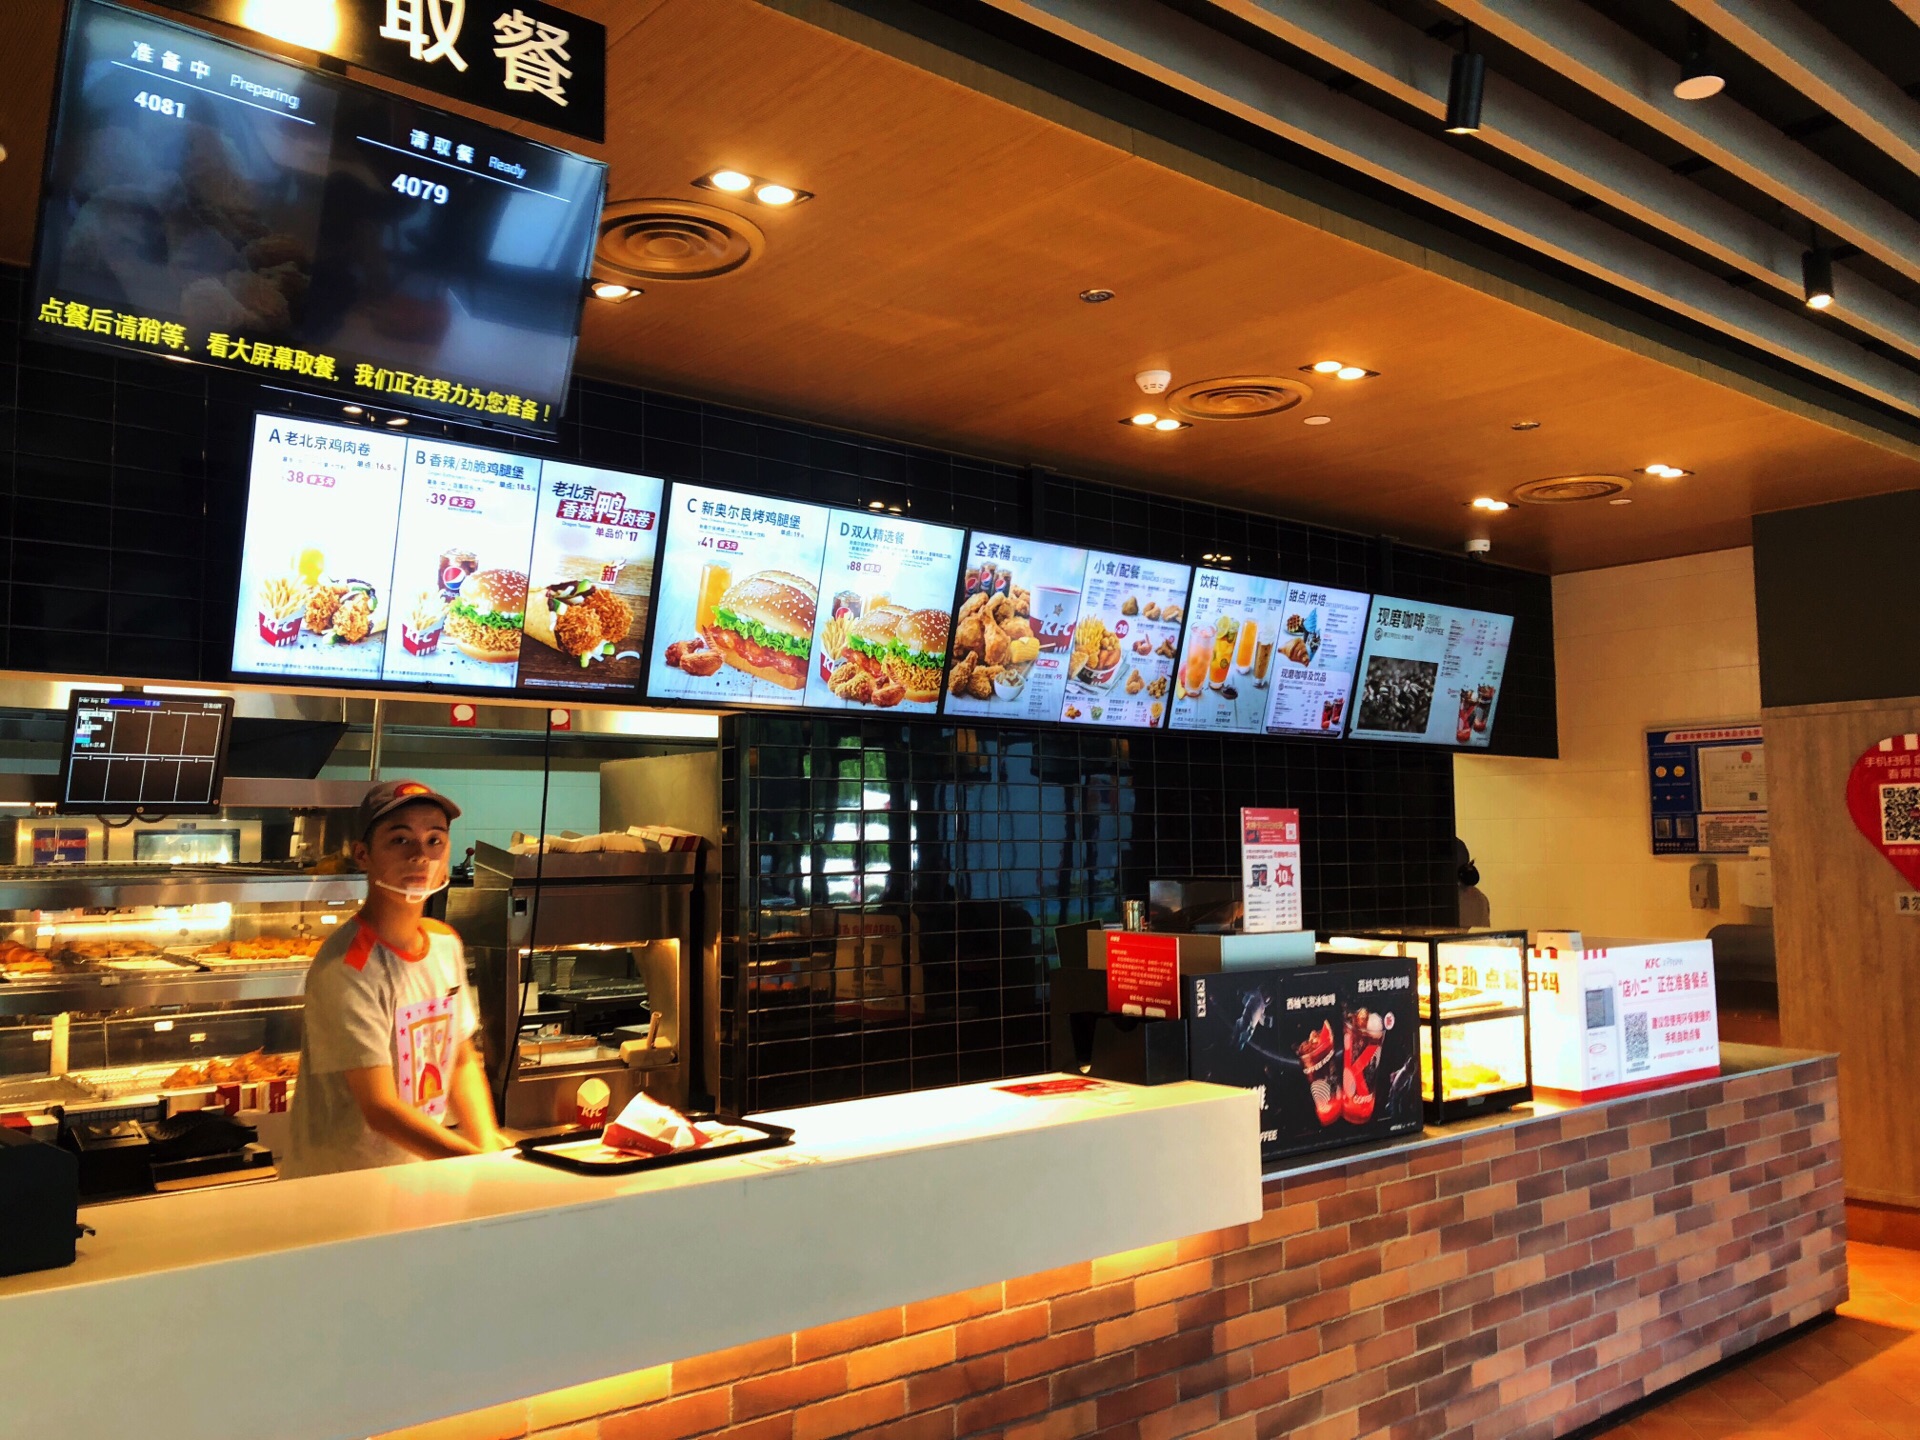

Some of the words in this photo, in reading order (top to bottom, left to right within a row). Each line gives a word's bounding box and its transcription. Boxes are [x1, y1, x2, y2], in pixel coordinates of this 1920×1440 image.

[380, 0, 572, 107] 取餐
[131, 40, 211, 80] 准备中
[230, 73, 300, 109] Preparing
[134, 90, 187, 119] 4081
[410, 128, 474, 165] 请取餐
[488, 155, 527, 180] Ready
[391, 172, 450, 205] 4079
[269, 428, 281, 444] A
[284, 431, 371, 457] 老北京鸡肉卷
[416, 451, 426, 464] B
[429, 453, 524, 480] 香辣/劲脆鸡腿堡
[552, 481, 597, 501] 老北京
[562, 491, 651, 529] 香辣鸭肉卷
[687, 498, 698, 513] C
[701, 501, 801, 530] 新奥尔良烤鸡腿堡
[595, 526, 624, 540] 单品价
[840, 522, 850, 536] D
[851, 525, 905, 545] 双人精选餐
[975, 541, 1011, 559] 全家桶
[1012, 555, 1032, 564] BUCKET
[601, 565, 617, 582] 新
[1094, 559, 1141, 579] 小食/配餐
[1200, 574, 1219, 590] 饮料
[1289, 588, 1327, 607] 甜点/烘焙
[263, 616, 293, 633] KFC
[1040, 618, 1071, 637] KFC
[1376, 607, 1426, 632] 现磨咖啡
[405, 630, 433, 645] KFC
[59, 839, 78, 848] KFC
[1645, 958, 1661, 969] KFC
[1657, 971, 1709, 993] 正在准备餐点
[1665, 1028, 1700, 1045] 手机自助点餐
[581, 1106, 603, 1119] KFC
[1260, 1129, 1278, 1143] FFEE
